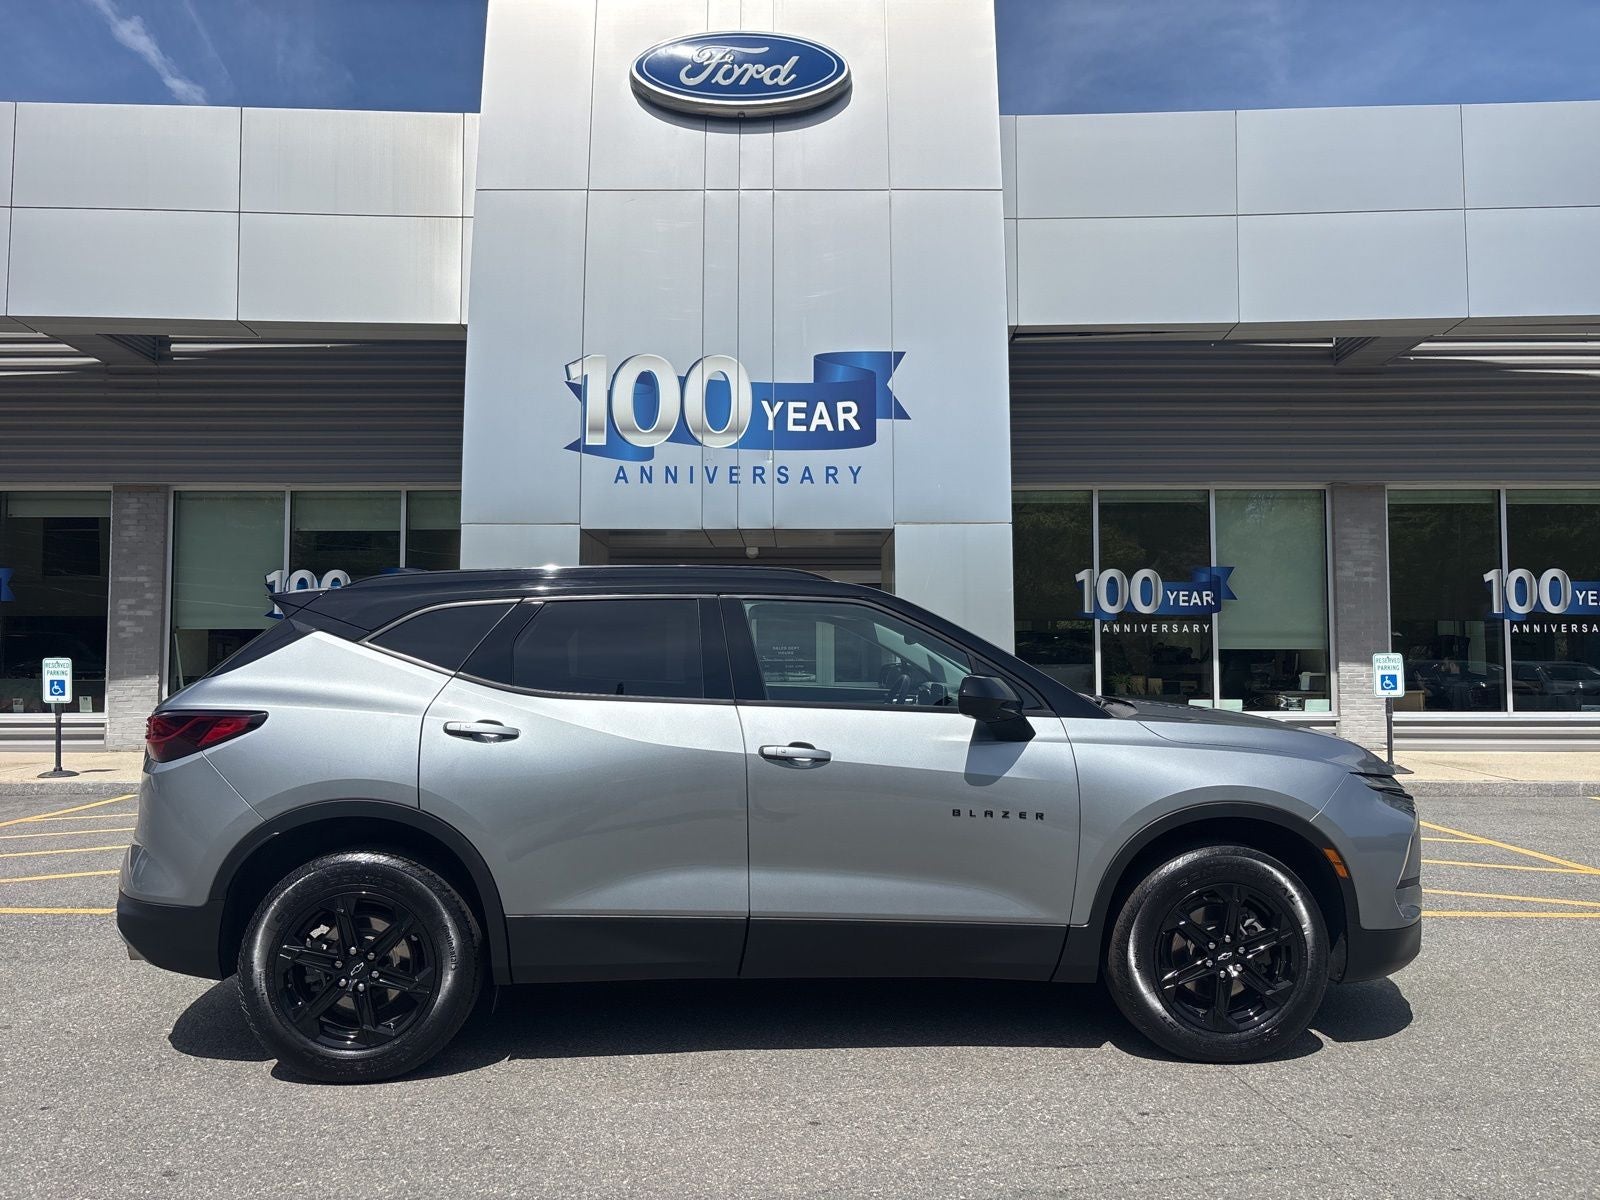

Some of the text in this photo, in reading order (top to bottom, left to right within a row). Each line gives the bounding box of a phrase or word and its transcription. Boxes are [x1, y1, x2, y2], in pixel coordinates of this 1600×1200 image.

[679, 46, 800, 87] Ford
[565, 353, 861, 448] 100 YEAR
[613, 465, 864, 485] ANNIVERSARY
[1074, 568, 1216, 614] 100 YEAR
[1483, 568, 1600, 614] 100 YE
[1102, 623, 1210, 634] ANNIVERSARY
[952, 809, 1044, 821] BLAZER
